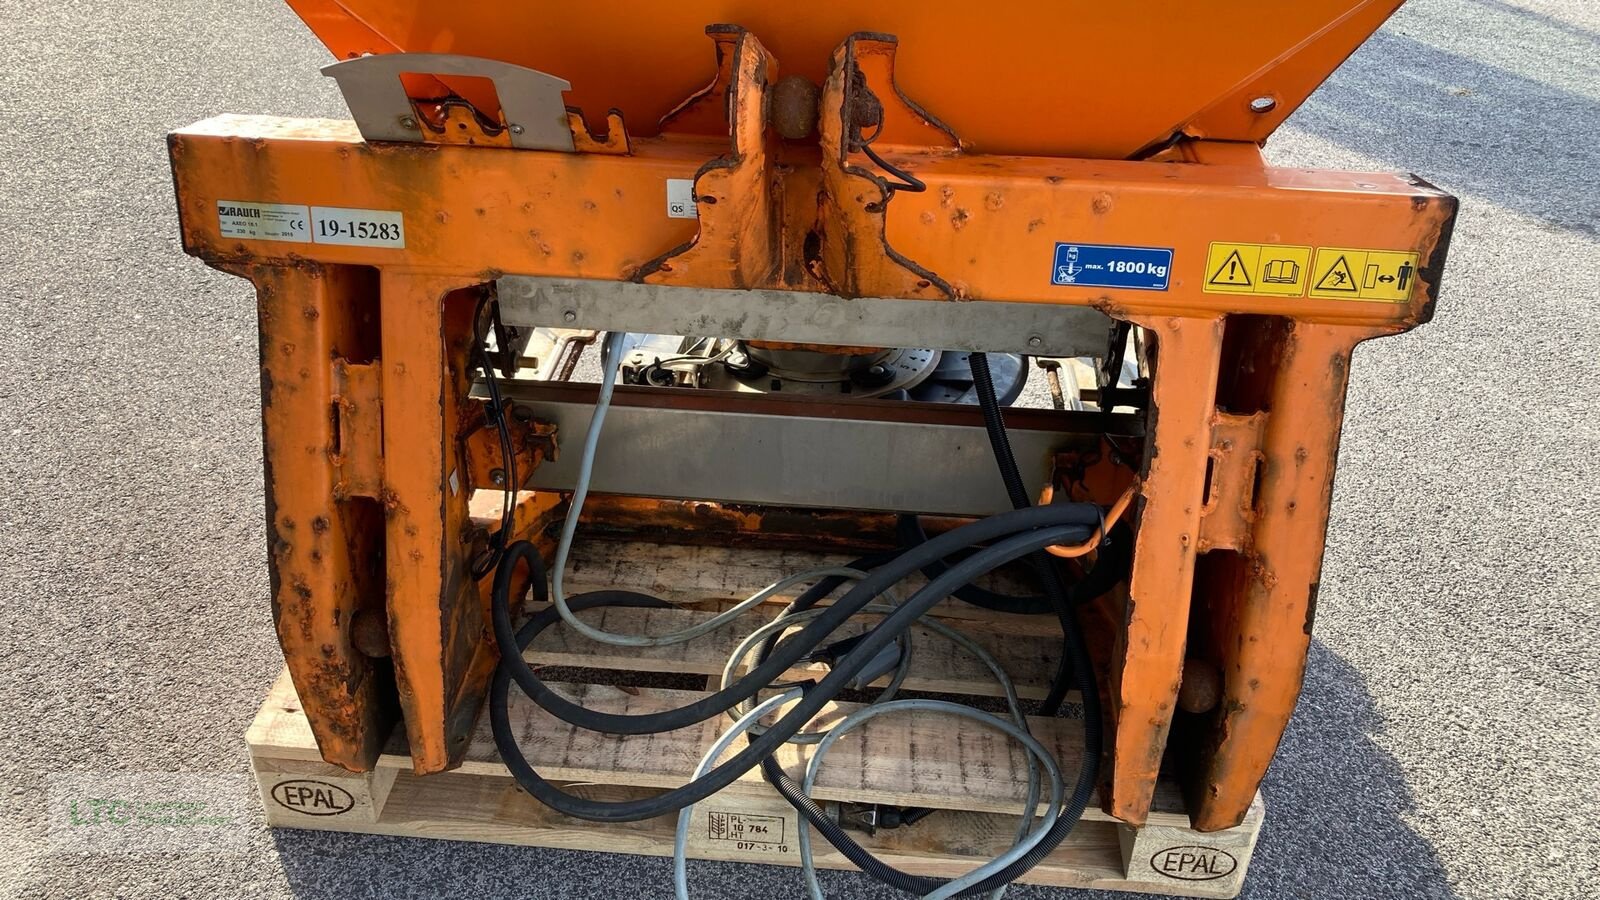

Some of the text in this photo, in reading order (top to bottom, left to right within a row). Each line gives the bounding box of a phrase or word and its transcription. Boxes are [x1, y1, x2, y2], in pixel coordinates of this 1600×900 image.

[229, 207, 261, 218] RAUCH
[290, 220, 304, 230] CE
[319, 218, 401, 241] 19-15283
[1107, 260, 1146, 274] 1800
[1147, 263, 1167, 278] kg
[284, 786, 344, 810] EPAL
[730, 831, 744, 839] HT
[748, 825, 768, 834] 784
[1163, 852, 1222, 874] EPAL
